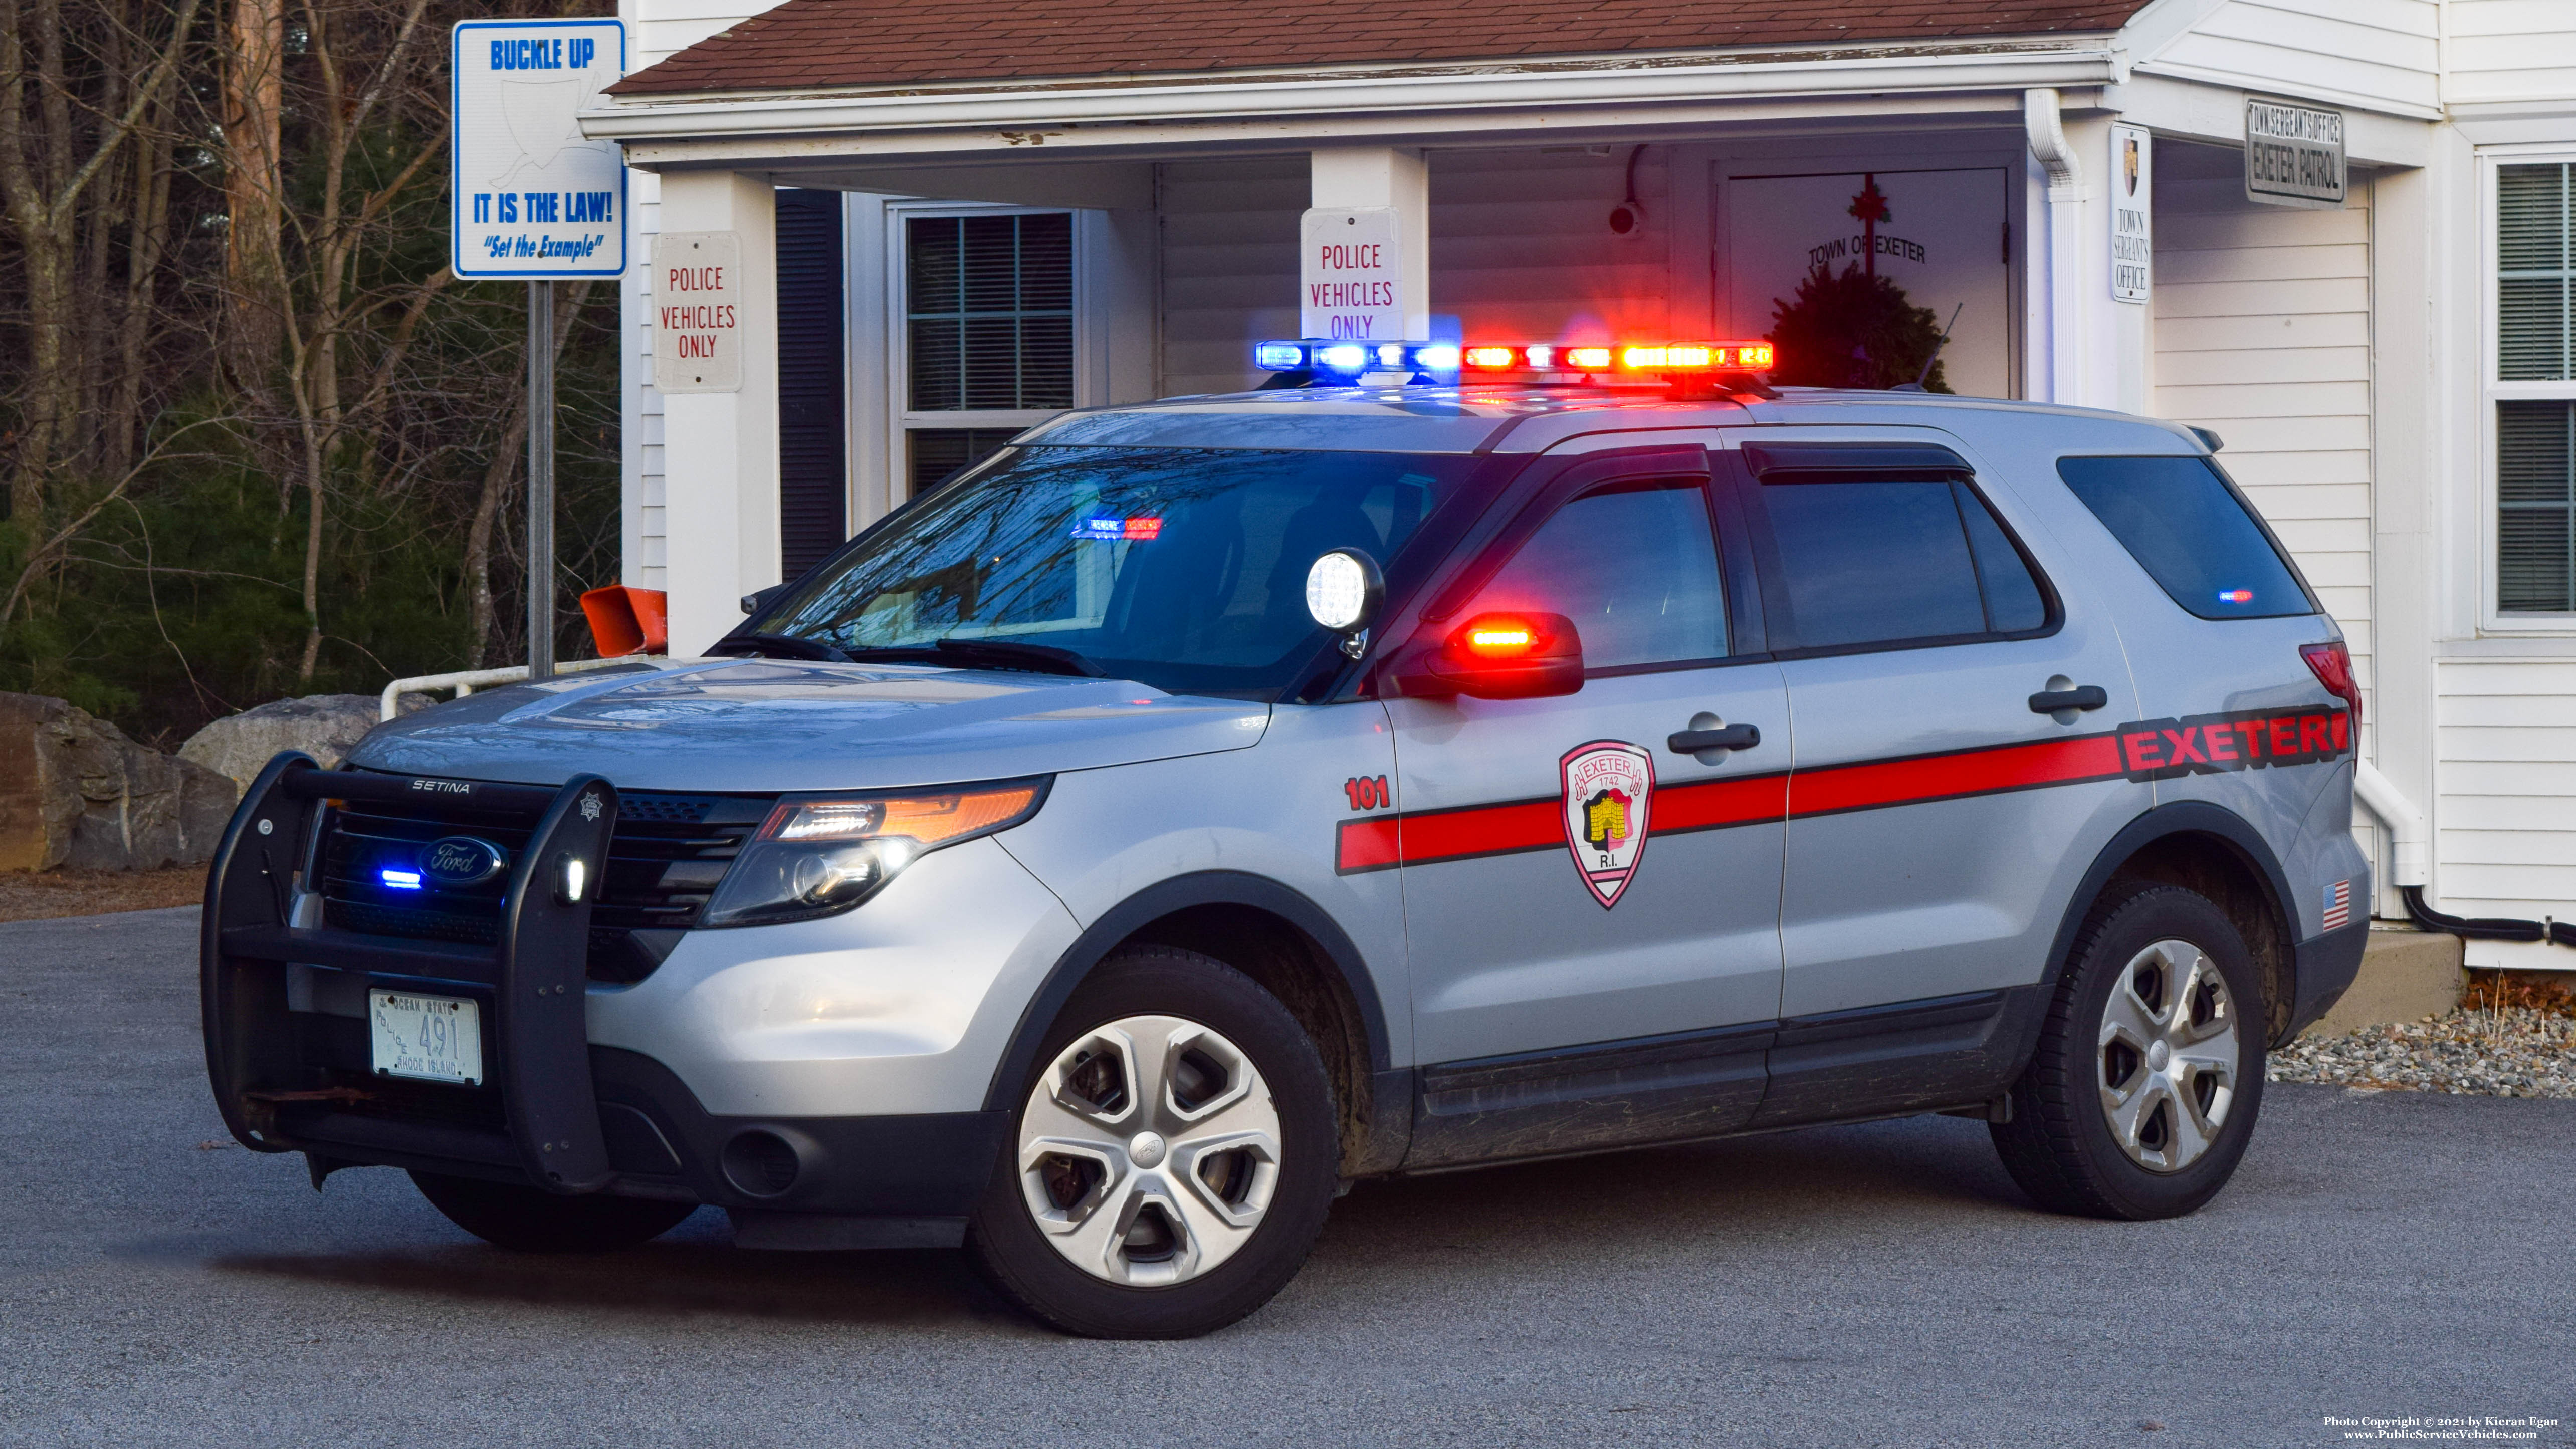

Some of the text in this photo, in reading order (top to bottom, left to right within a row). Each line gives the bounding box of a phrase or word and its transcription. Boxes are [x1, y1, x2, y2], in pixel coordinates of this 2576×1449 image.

[491, 39, 594, 70] BUCKLE UP
[2250, 104, 2269, 134] TOWN
[2313, 114, 2338, 143] OFFICE
[2253, 141, 2339, 189] EXETER PATROL
[474, 192, 612, 223] IT IS THE LAW!
[2118, 209, 2144, 234] TOWN
[515, 234, 536, 257] the
[1322, 244, 1381, 269] POLICE
[1808, 238, 1846, 267] TOWN
[1875, 235, 1925, 264] EXETER
[670, 267, 723, 291] POLICE
[2116, 264, 2146, 290] OFFICE
[1311, 281, 1392, 307] VEHICLES
[661, 305, 735, 329] VEHICLES
[1331, 315, 1373, 340] ONLY
[679, 335, 717, 358] ONLY
[2123, 716, 2331, 772] EXETER
[1583, 758, 1631, 778] EXETER
[412, 780, 470, 794] SETINA
[1344, 775, 1390, 811] 101
[1599, 776, 1619, 786] 1742
[431, 843, 478, 872] Ford
[1600, 853, 1617, 868] R.I.
[394, 997, 453, 1015] OCEAN STATE
[377, 1009, 407, 1054] POLICE
[420, 1014, 458, 1060] 491
[397, 1056, 456, 1076] RHODE ISLAND
